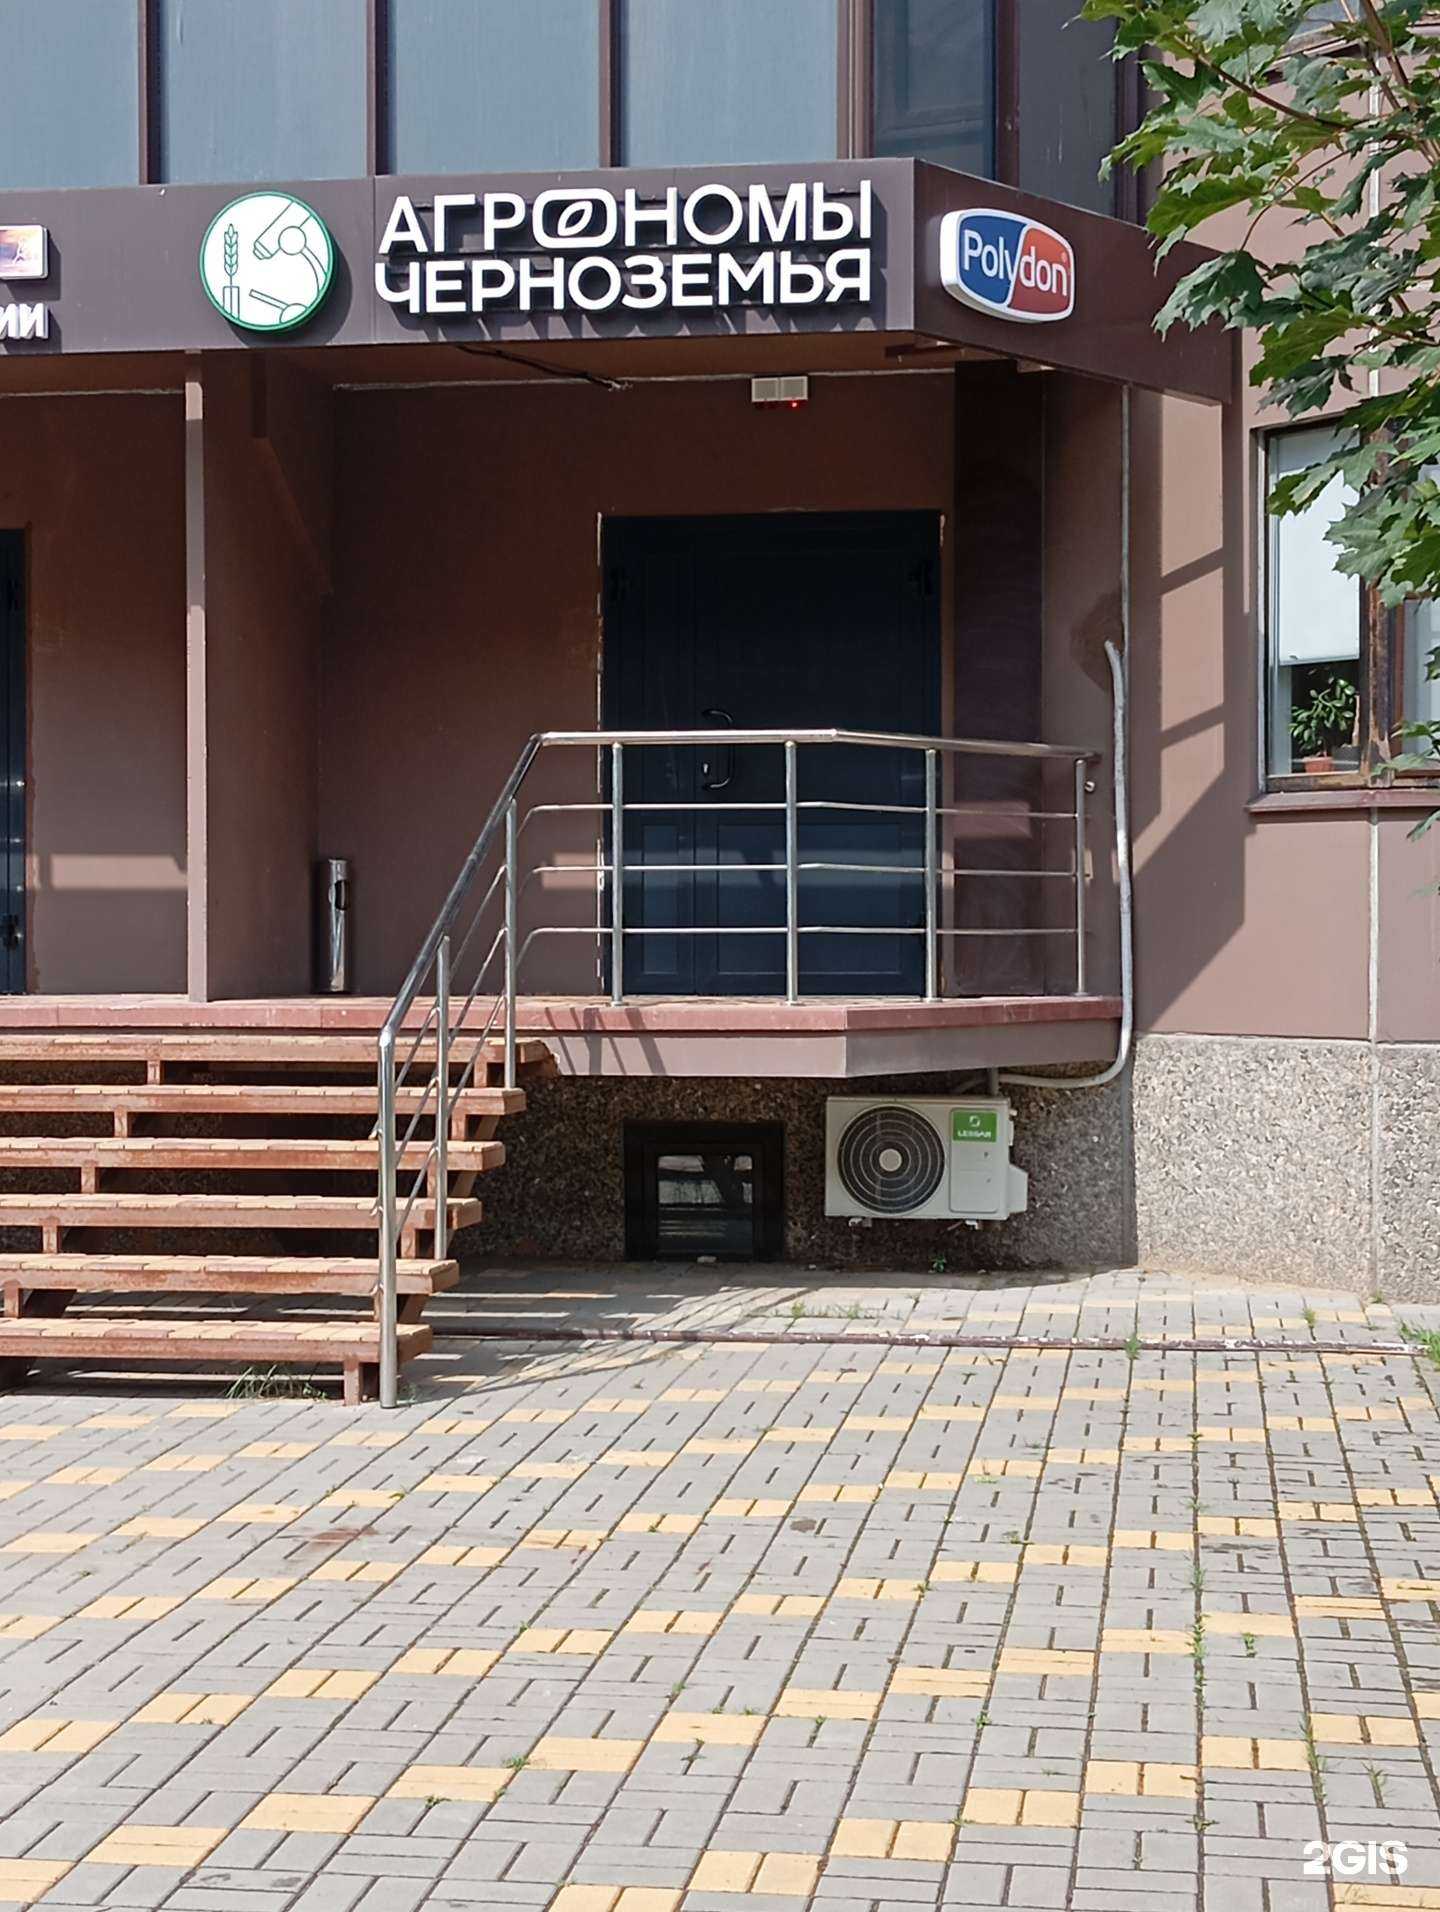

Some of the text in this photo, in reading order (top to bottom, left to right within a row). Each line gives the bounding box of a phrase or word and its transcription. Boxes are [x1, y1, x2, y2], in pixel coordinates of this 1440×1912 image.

[379, 180, 871, 253] АГРОНОМЫ
[375, 249, 871, 313] ЧЕРНОЗЕМЬЯ
[963, 229, 1068, 296] Polydon
